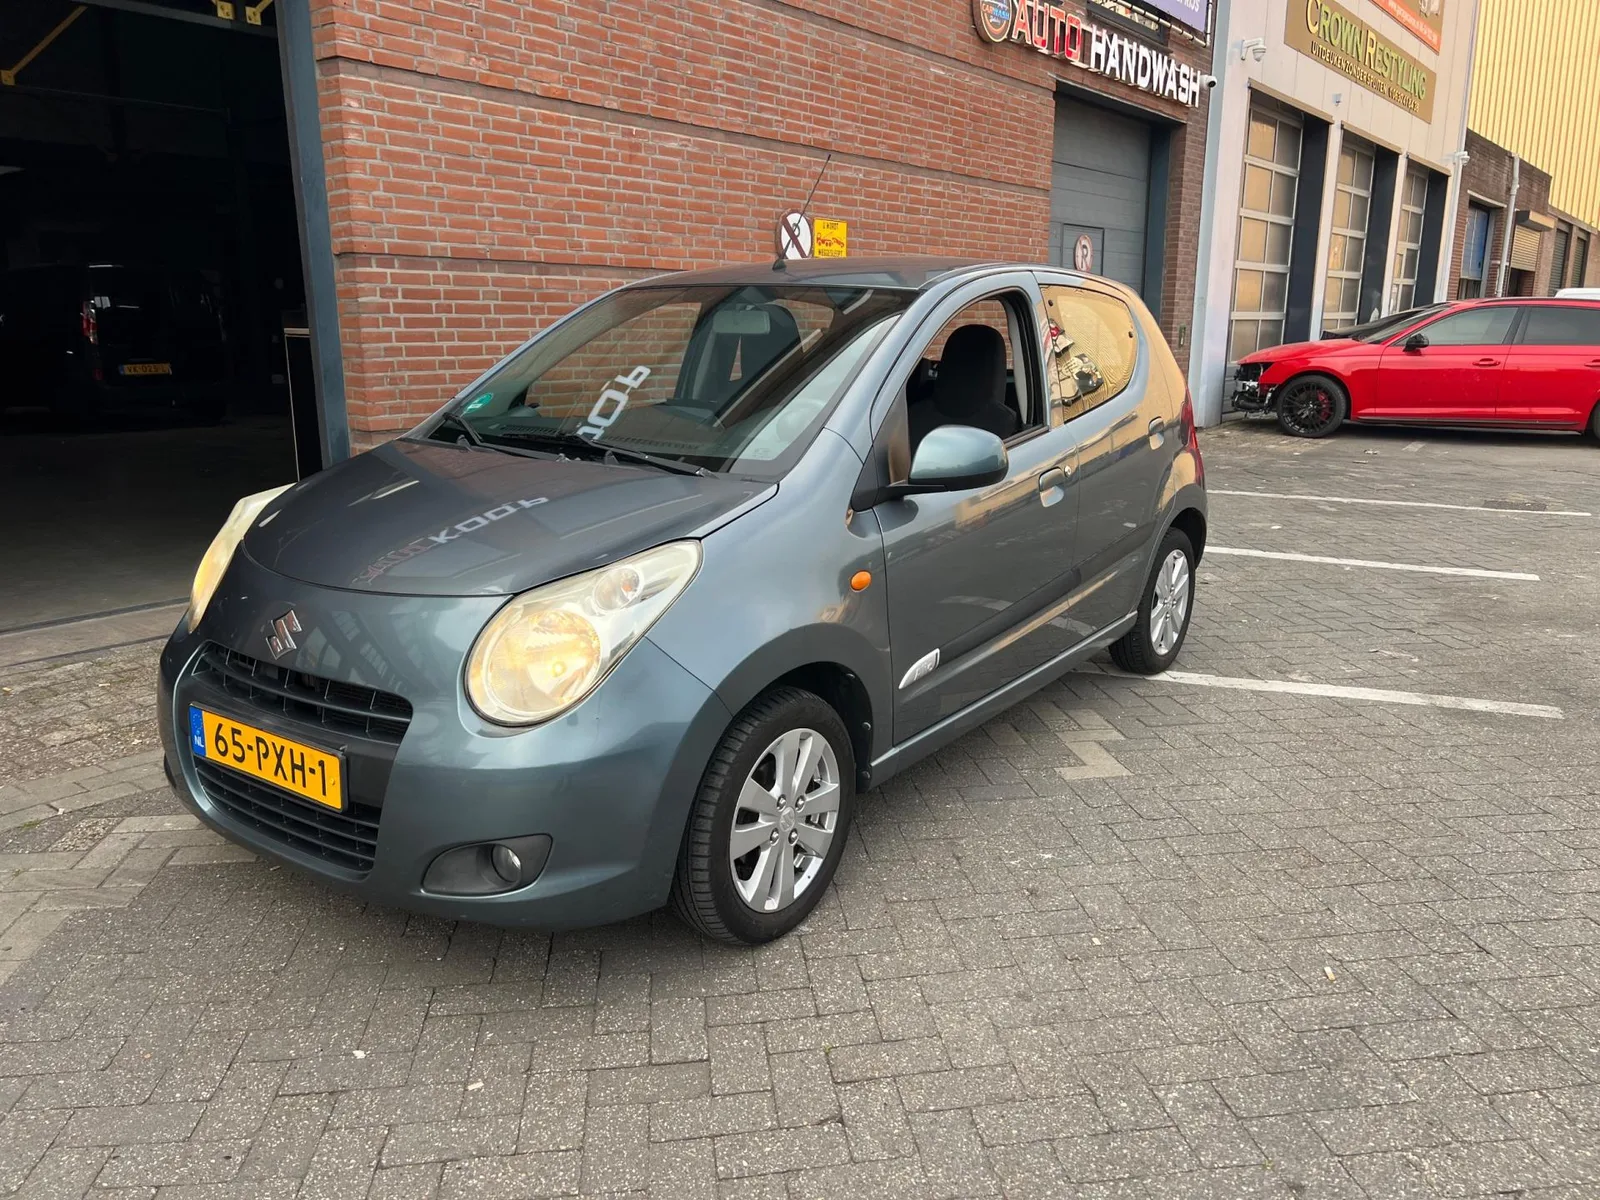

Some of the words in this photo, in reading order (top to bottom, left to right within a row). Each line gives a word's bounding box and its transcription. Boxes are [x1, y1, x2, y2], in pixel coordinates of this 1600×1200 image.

[1012, 0, 1081, 62] AUTO
[1090, 24, 1200, 108] HANDWASH
[1306, 0, 1363, 62] CROWN
[1364, 29, 1426, 100] RESTYLING
[214, 722, 327, 797] 65-PXH-1
